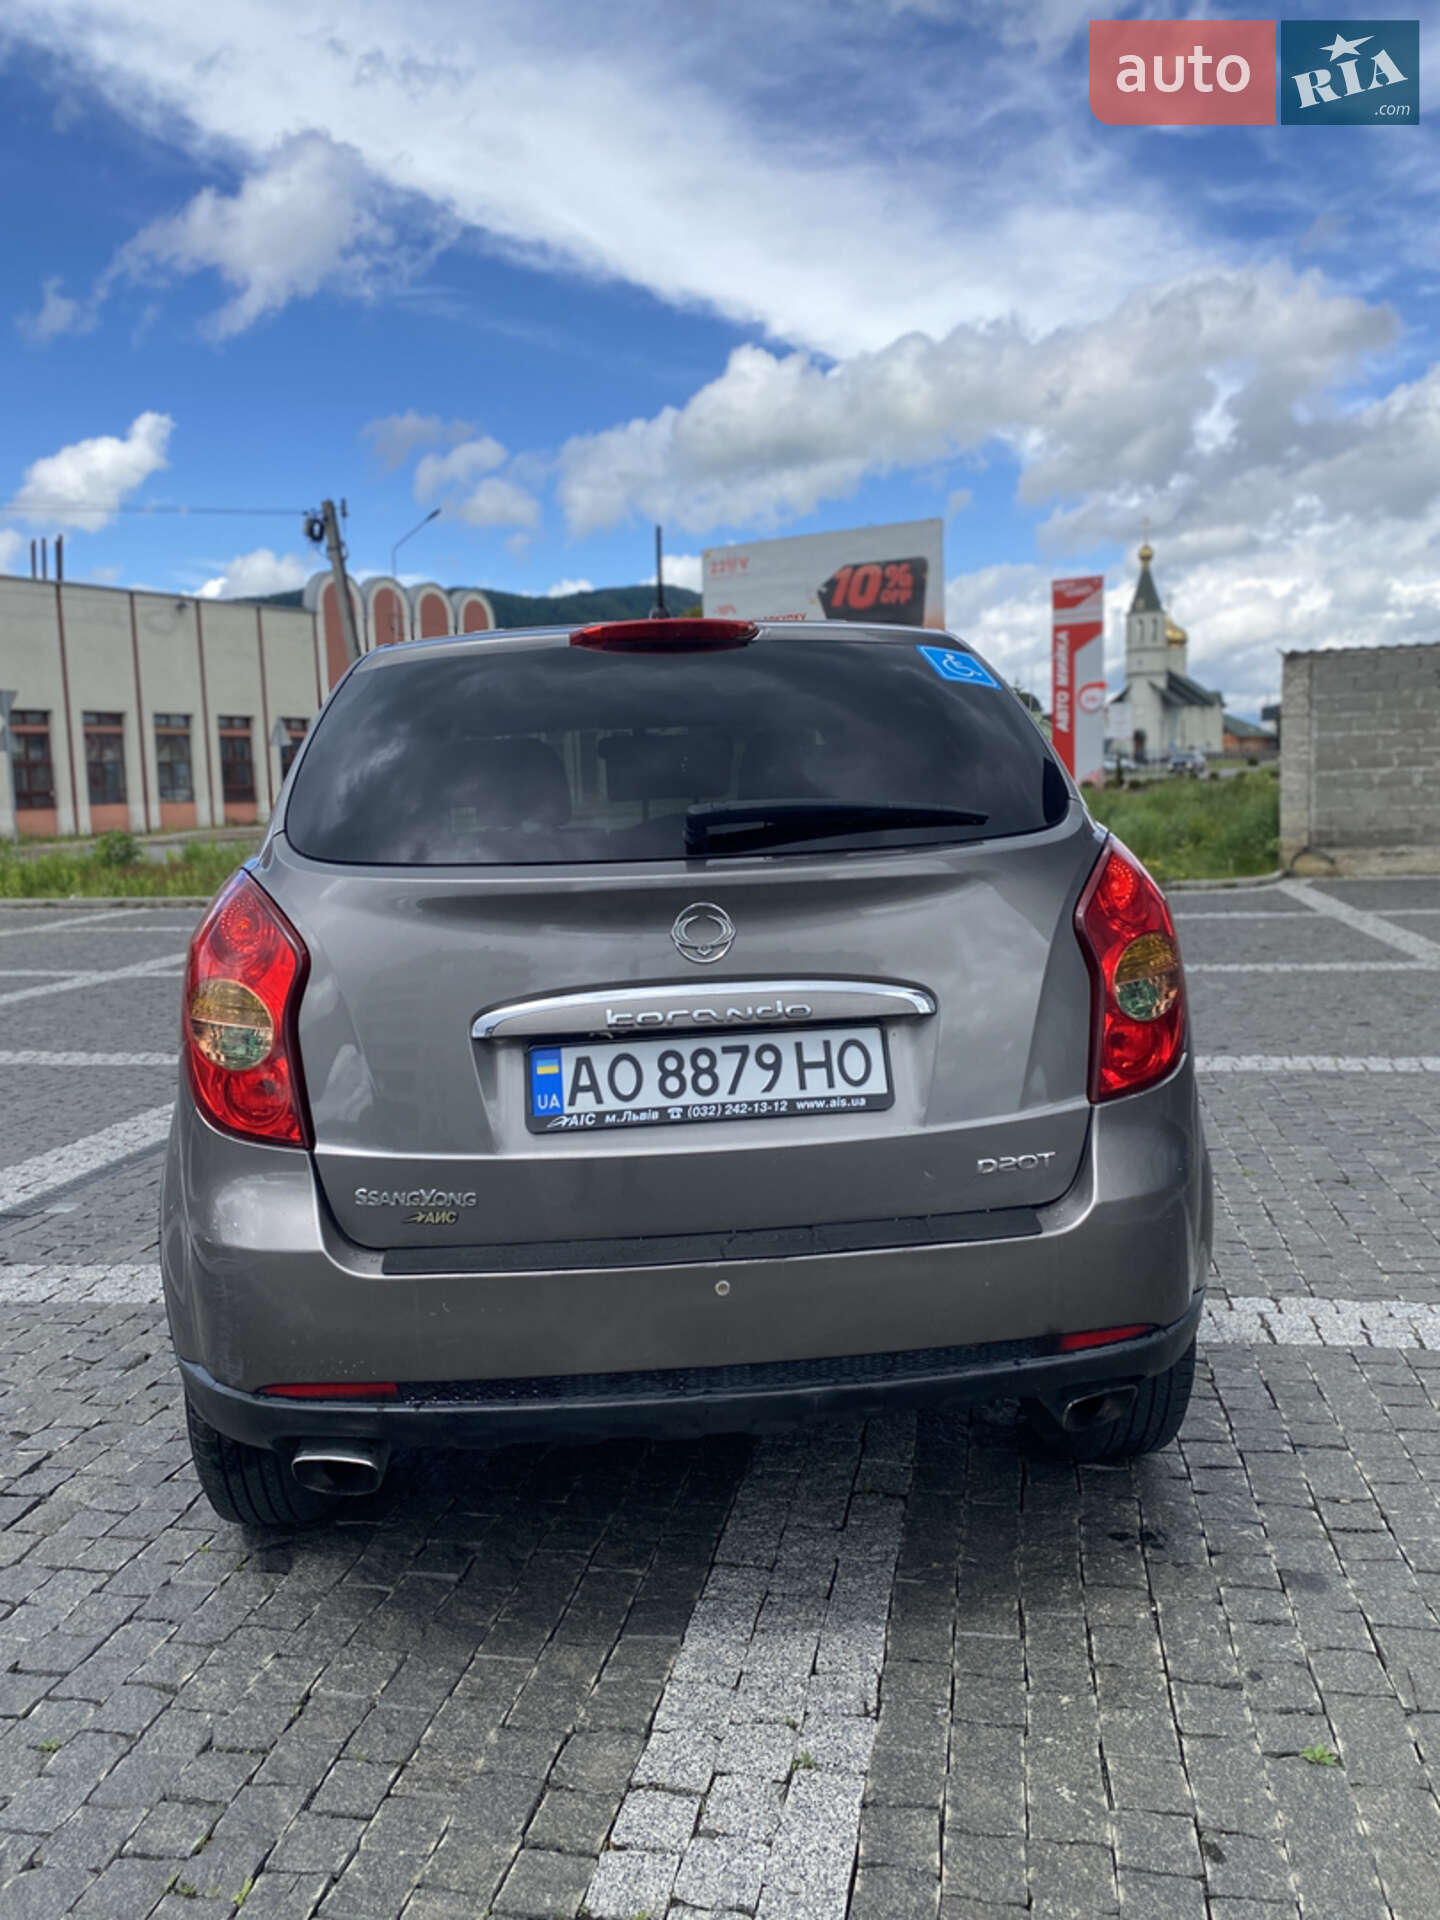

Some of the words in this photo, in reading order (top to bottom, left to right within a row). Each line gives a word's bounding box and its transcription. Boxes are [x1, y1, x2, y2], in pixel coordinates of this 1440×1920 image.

[880, 588, 913, 605] OFF
[657, 1043, 783, 1099] 8879
[537, 1094, 561, 1110] UA
[687, 1103, 722, 1119] (032)
[725, 1101, 788, 1116] 242-13-12
[796, 1096, 867, 1110] www.ais.ua
[977, 1151, 1056, 1174] D20T
